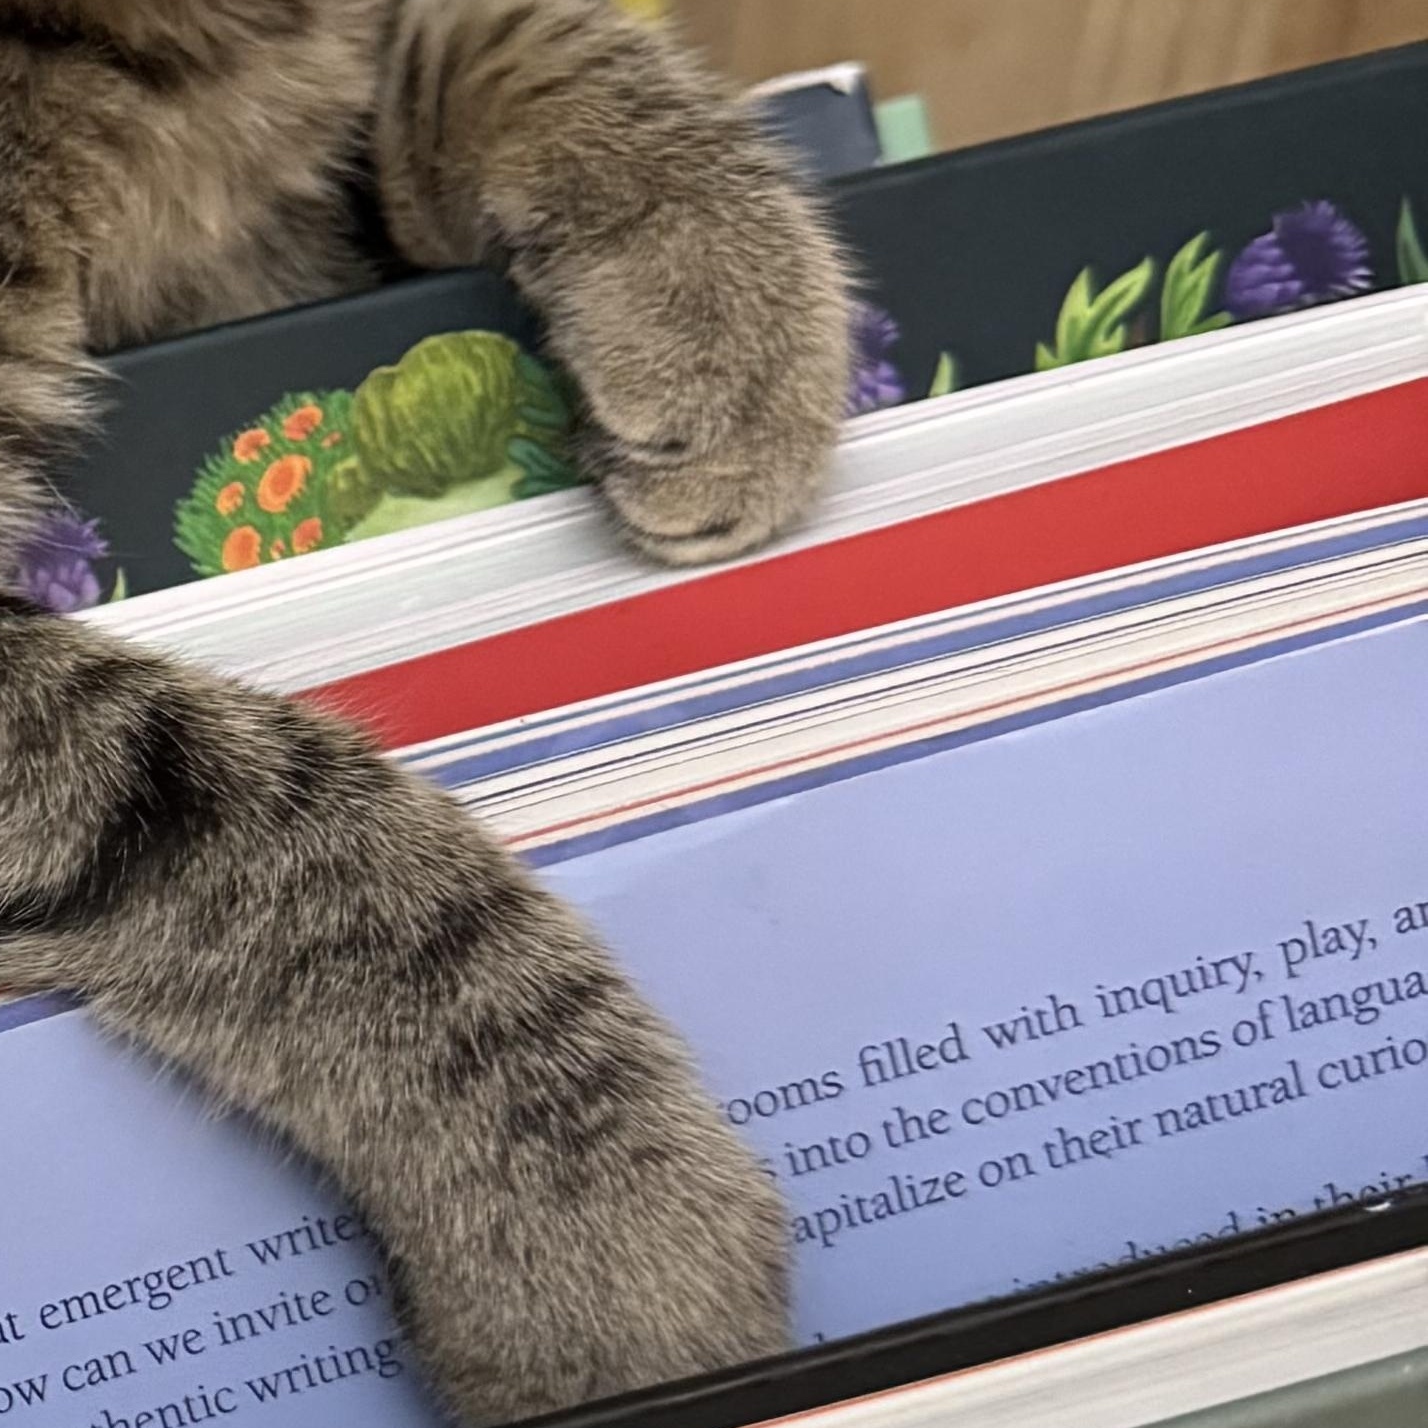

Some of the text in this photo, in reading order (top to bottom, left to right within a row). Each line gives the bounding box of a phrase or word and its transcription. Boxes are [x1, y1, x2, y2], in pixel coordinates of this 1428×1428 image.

[726, 1070, 845, 1125] ooms
[859, 1022, 971, 1088] filled
[982, 995, 1086, 1049] with
[1095, 952, 1265, 1019] inquiry,
[1277, 919, 1378, 979] play,
[785, 1132, 872, 1177] into
[883, 1107, 951, 1149] the
[962, 1030, 1222, 1126] conventions
[1233, 1000, 1275, 1047] of
[1280, 971, 1428, 1033] langua
[793, 1036, 1428, 1248] apitalize on their natural curio
[40, 1250, 235, 1330] emergent
[246, 1214, 358, 1265] write
[63, 1351, 136, 1392] can
[143, 1327, 206, 1365] we
[213, 1290, 334, 1346] invite
[245, 1338, 406, 1403] writing
